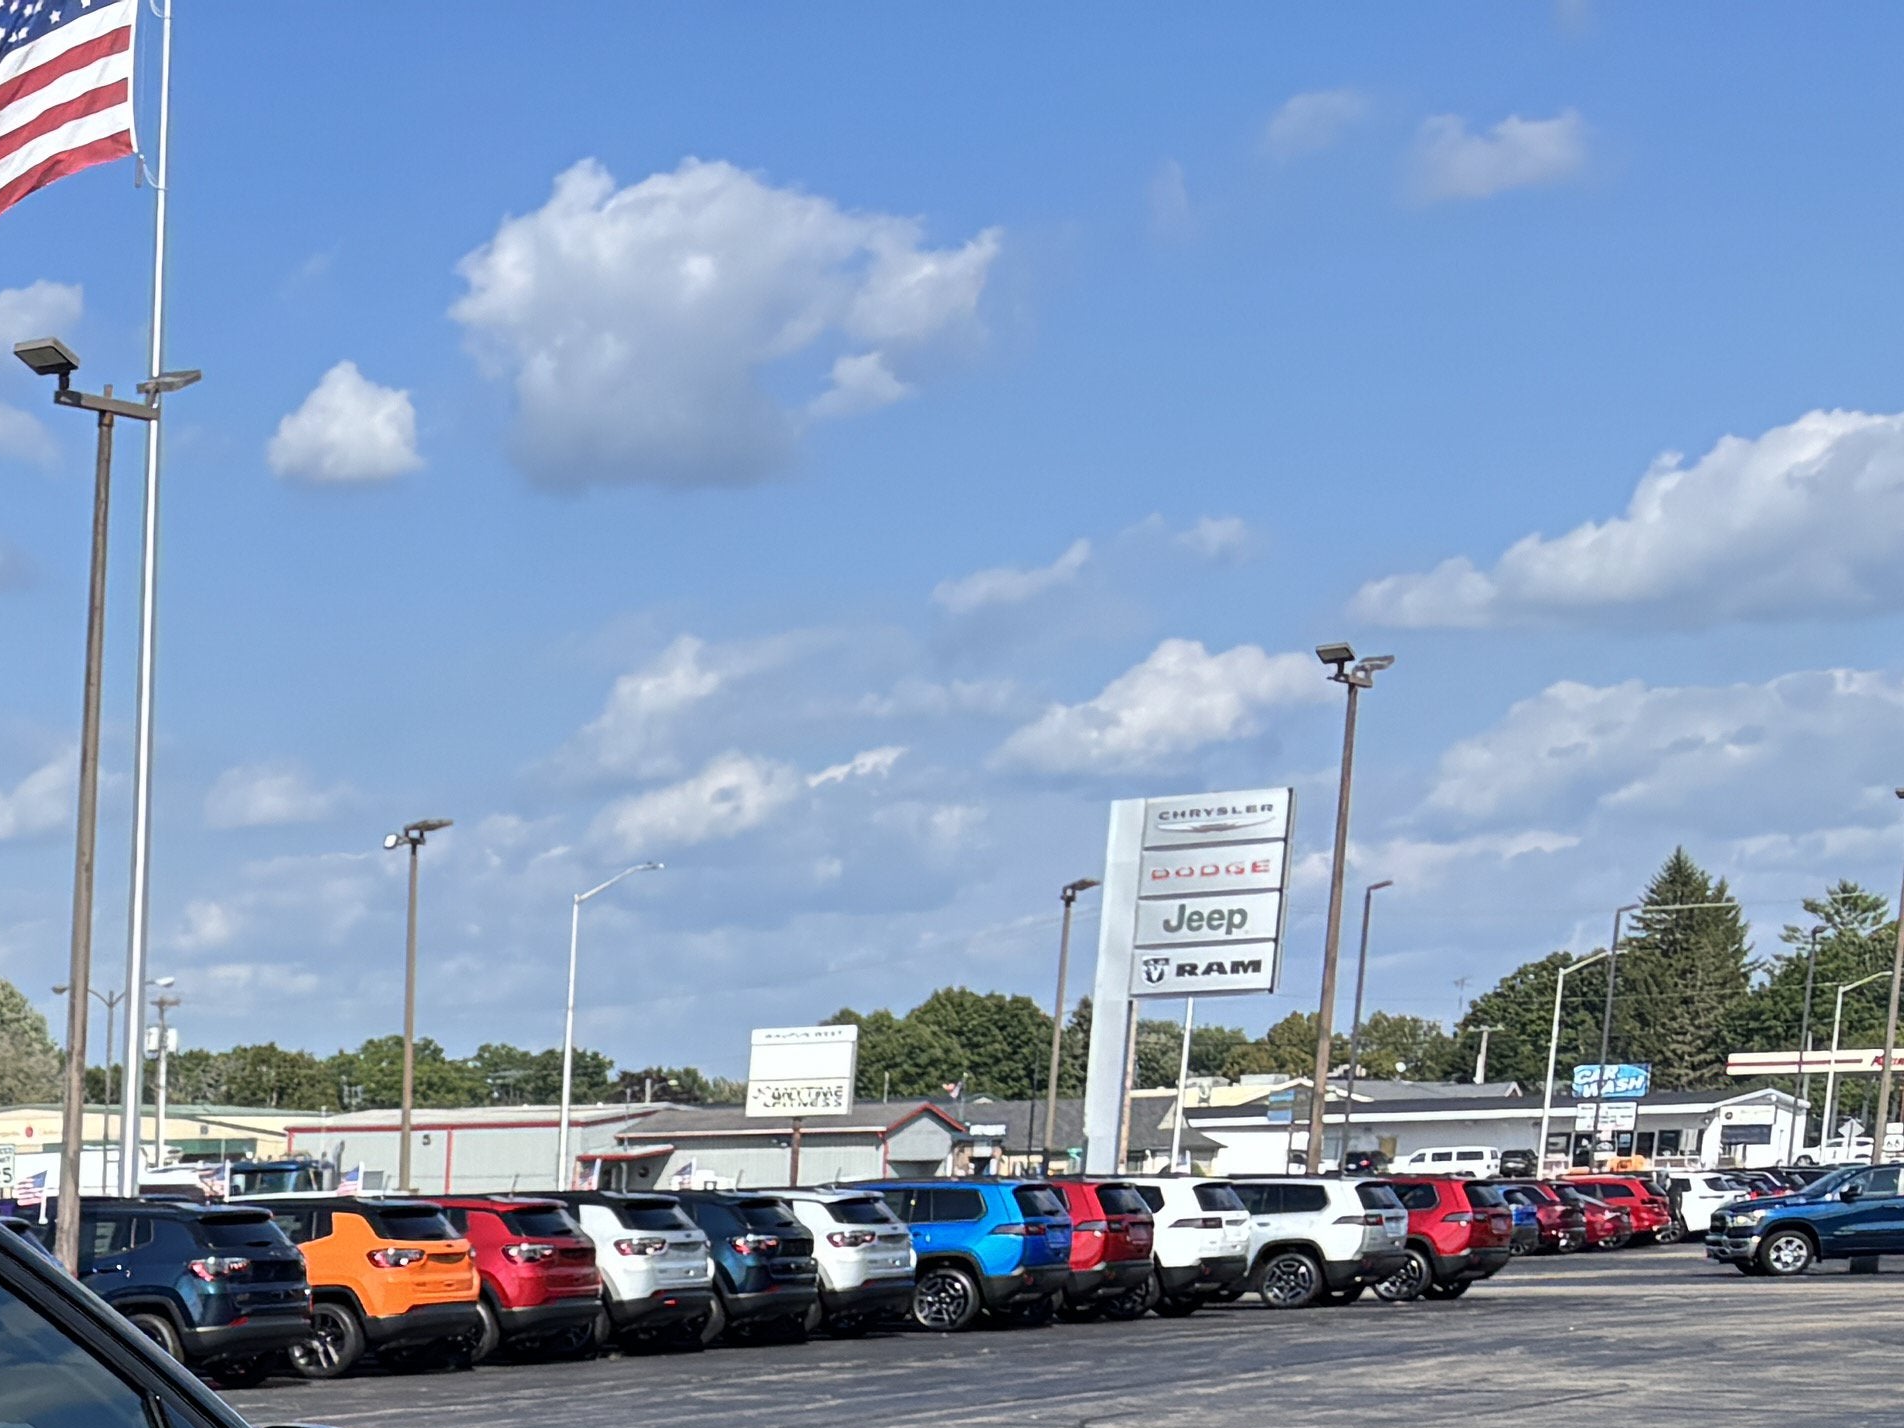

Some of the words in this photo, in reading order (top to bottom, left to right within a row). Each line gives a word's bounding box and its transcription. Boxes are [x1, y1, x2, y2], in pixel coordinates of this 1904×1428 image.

[1158, 803, 1274, 821] CHRYSLER
[1151, 858, 1271, 881] DODGE
[1162, 903, 1249, 935] Jeep
[1175, 958, 1263, 978] RAM
[1573, 1064, 1619, 1085] CAR
[1582, 1074, 1645, 1098] WASH
